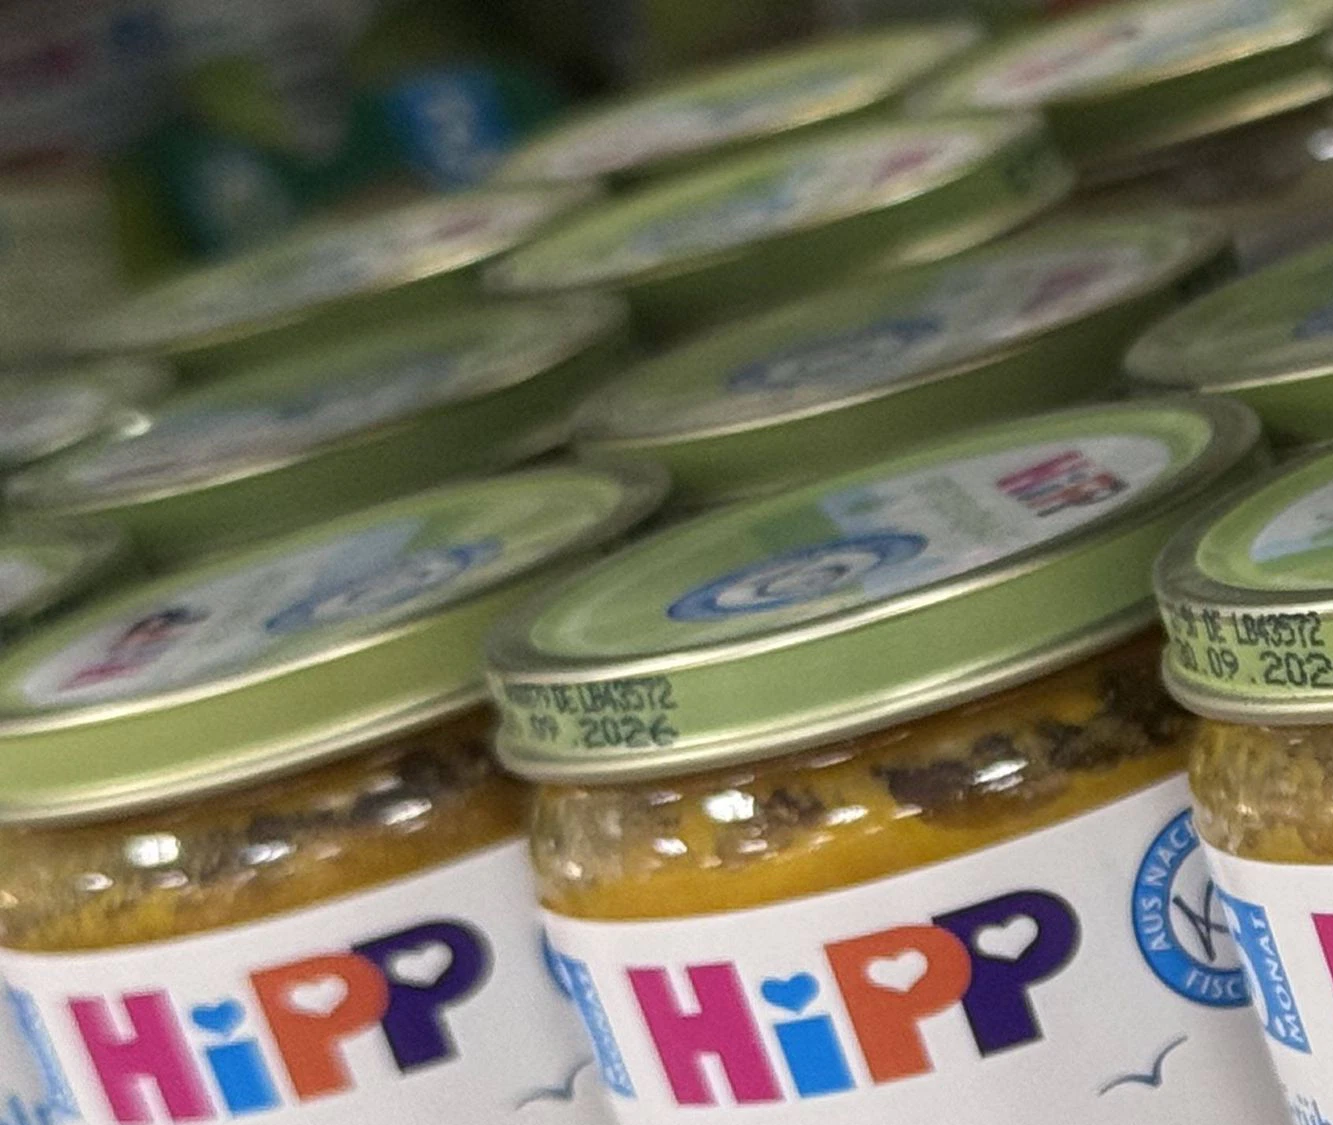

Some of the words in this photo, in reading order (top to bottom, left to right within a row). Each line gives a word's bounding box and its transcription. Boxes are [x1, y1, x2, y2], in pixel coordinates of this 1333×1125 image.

[1142, 897, 1172, 951] AUS
[1250, 913, 1305, 1044] MONAT
[625, 888, 1082, 1108] HiPP
